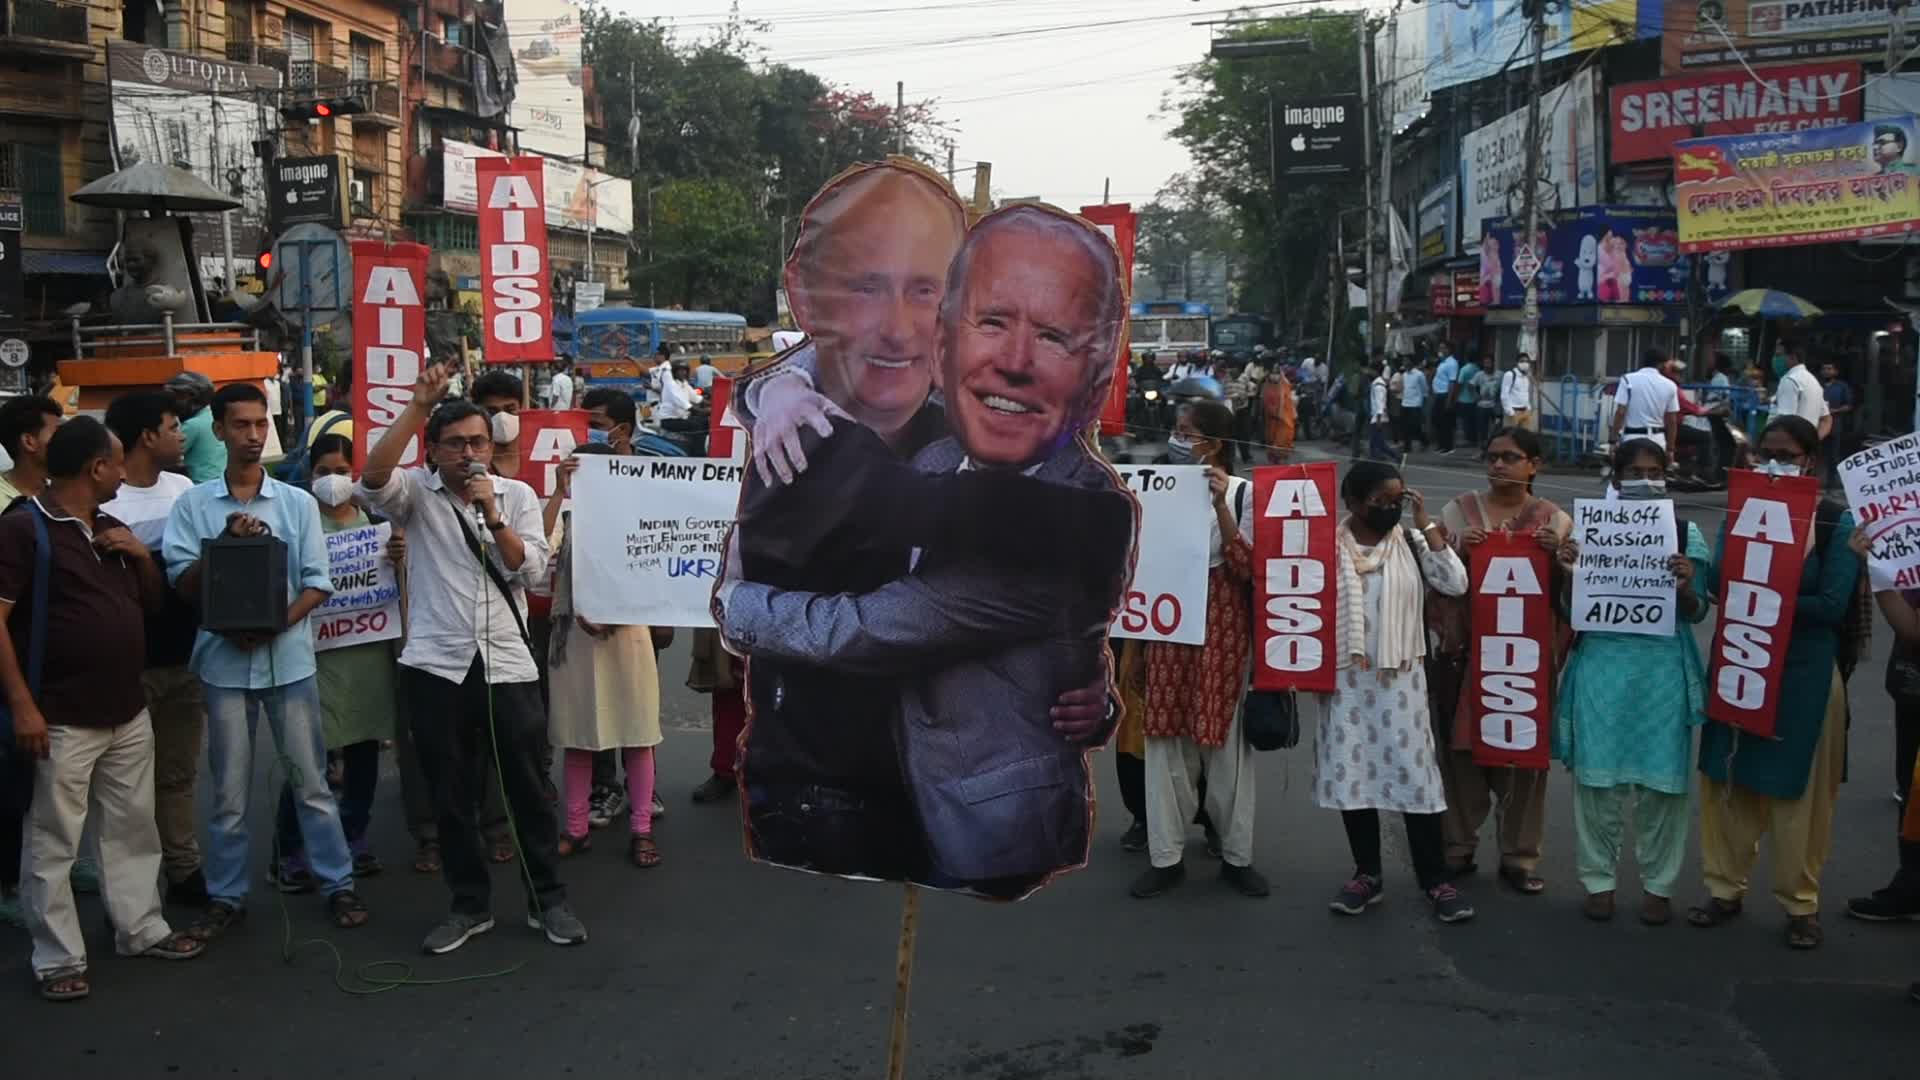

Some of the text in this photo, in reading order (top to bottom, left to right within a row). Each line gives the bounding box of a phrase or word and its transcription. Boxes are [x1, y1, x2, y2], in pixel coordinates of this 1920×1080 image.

[170, 55, 249, 88] UTOPIA
[1620, 72, 1849, 132] SREEMANY
[1284, 104, 1345, 129] imagine
[279, 163, 328, 185] imagine
[487, 175, 543, 344] AIDSO
[650, 462, 697, 481] MANY
[1845, 449, 1886, 471] DEAR
[1581, 506, 1629, 525] Hands
[1585, 528, 1664, 546] Russian
[680, 545, 697, 555] OF
[1264, 479, 1327, 671] AIDSO
[1584, 571, 1618, 585] from
[1585, 602, 1663, 625] AIDSO
[1717, 497, 1795, 710] AIDSO
[317, 611, 388, 641] AIDSO
[1479, 556, 1544, 750] AIDSO
